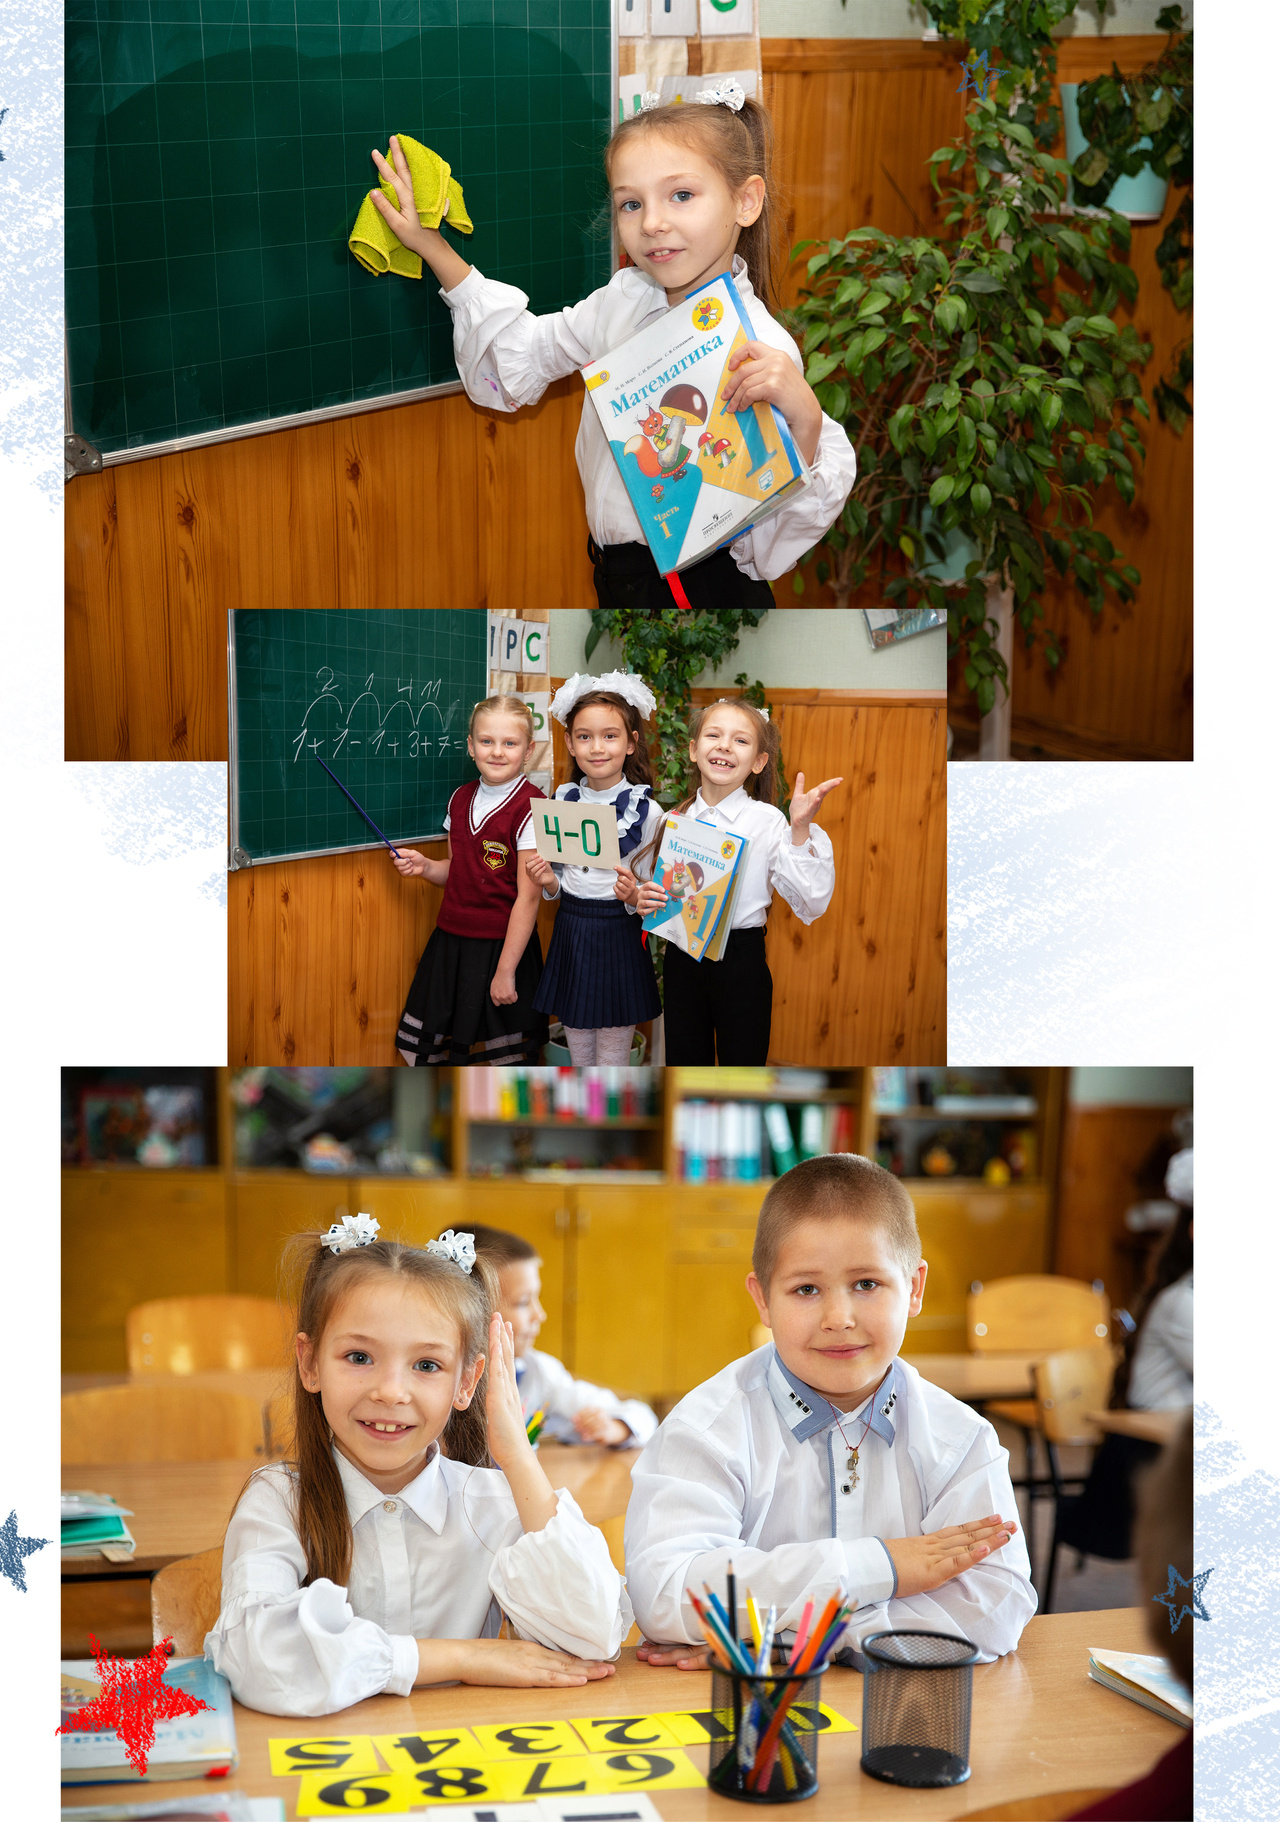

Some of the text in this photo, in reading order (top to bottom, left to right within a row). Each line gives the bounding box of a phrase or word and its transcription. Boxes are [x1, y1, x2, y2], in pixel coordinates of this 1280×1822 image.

[609, 335, 724, 418] Математика
[653, 506, 680, 522] Часть
[659, 520, 673, 540] 1
[316, 666, 339, 692] 2
[398, 673, 413, 700] 4
[490, 852, 501, 860] 28
[667, 839, 726, 872] Математика
[692, 894, 717, 941] 1
[495, 1725, 563, 1754] 3
[591, 1717, 661, 1745] 2
[285, 1740, 354, 1771] 5
[393, 1736, 460, 1764] 4
[415, 1767, 488, 1799] 8
[523, 1762, 587, 1795] 7
